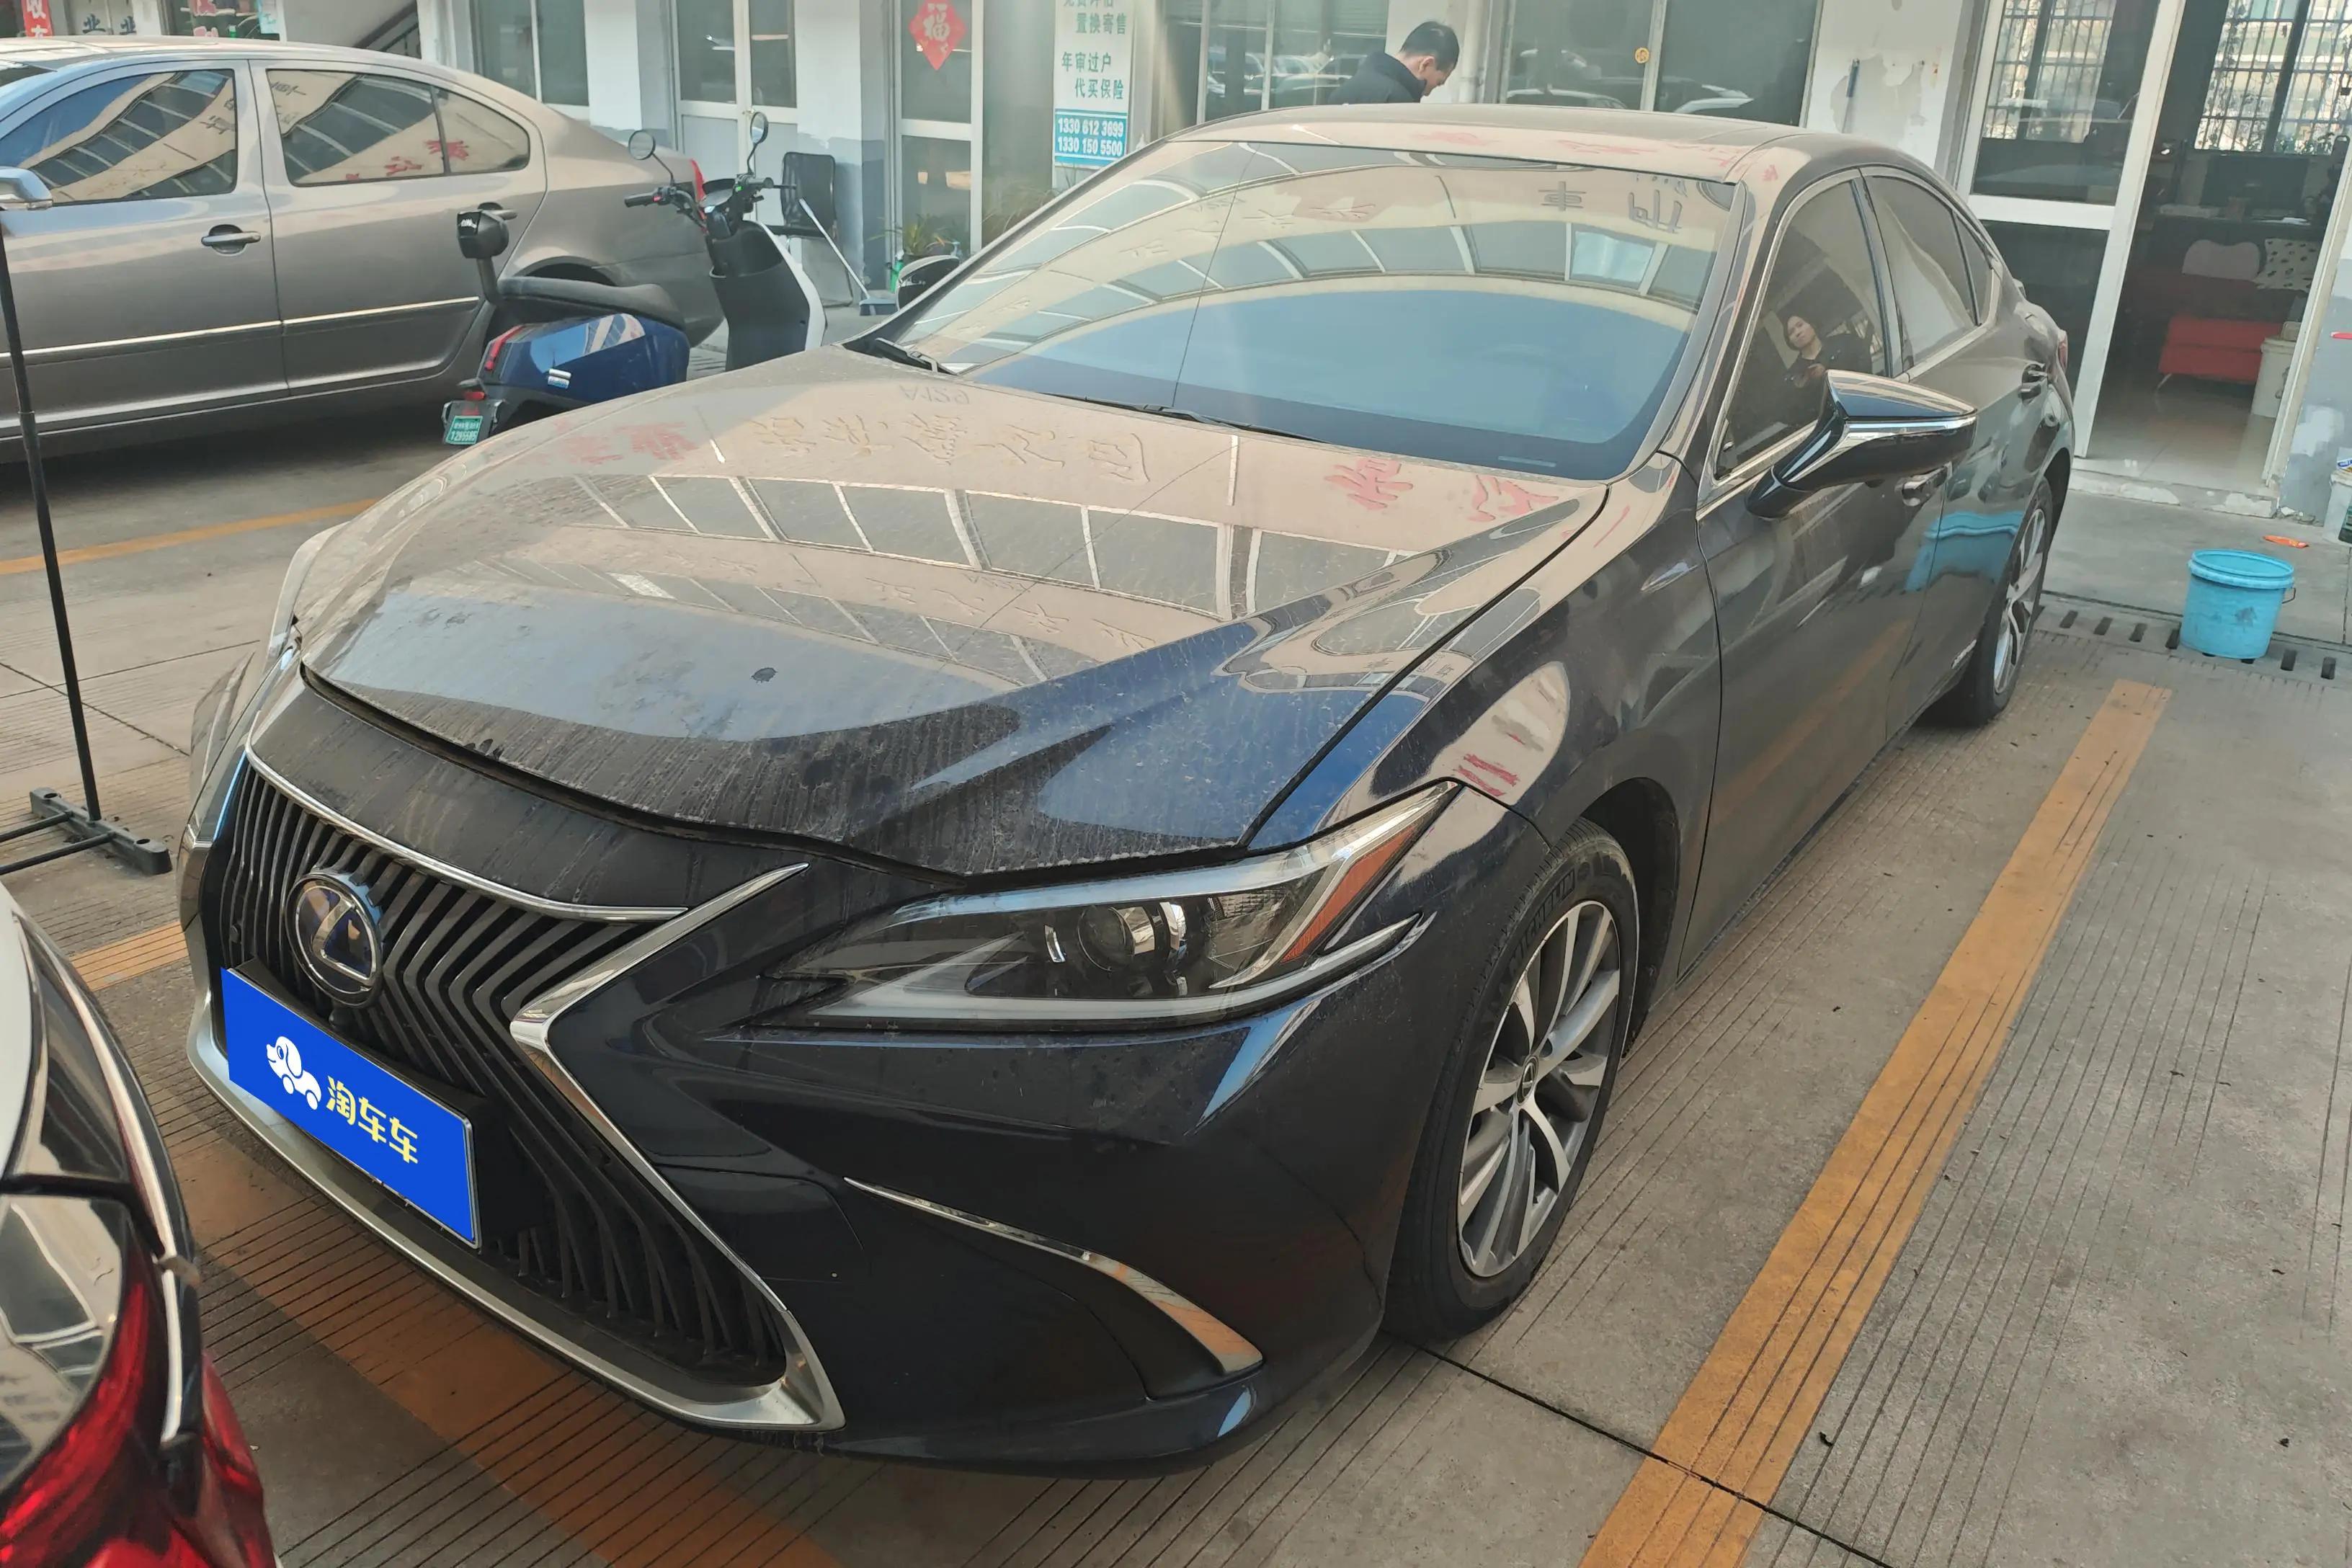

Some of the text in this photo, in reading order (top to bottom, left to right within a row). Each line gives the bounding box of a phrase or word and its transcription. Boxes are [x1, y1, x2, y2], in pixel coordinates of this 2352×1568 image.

[923, 2, 950, 42] 福
[1061, 51, 1112, 73] 年审过户
[1075, 78, 1124, 99] 代买保险
[1058, 117, 1080, 134] 1330
[1057, 136, 1123, 156] 1330 150 5500
